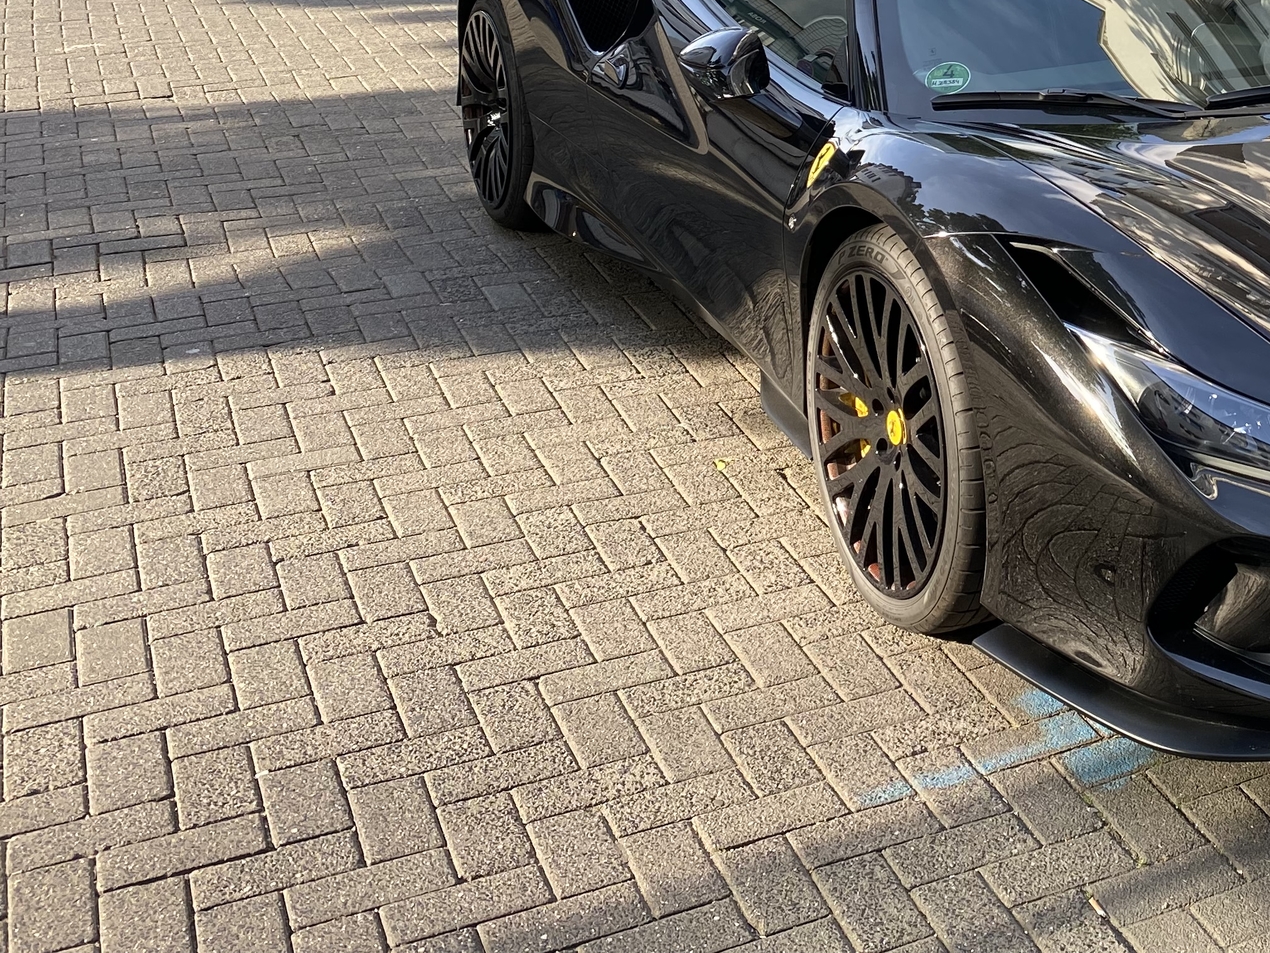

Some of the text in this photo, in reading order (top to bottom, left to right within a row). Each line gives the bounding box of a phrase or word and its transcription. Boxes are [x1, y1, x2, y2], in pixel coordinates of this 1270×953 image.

[943, 64, 955, 78] 4
[838, 245, 886, 265] P ZERO
